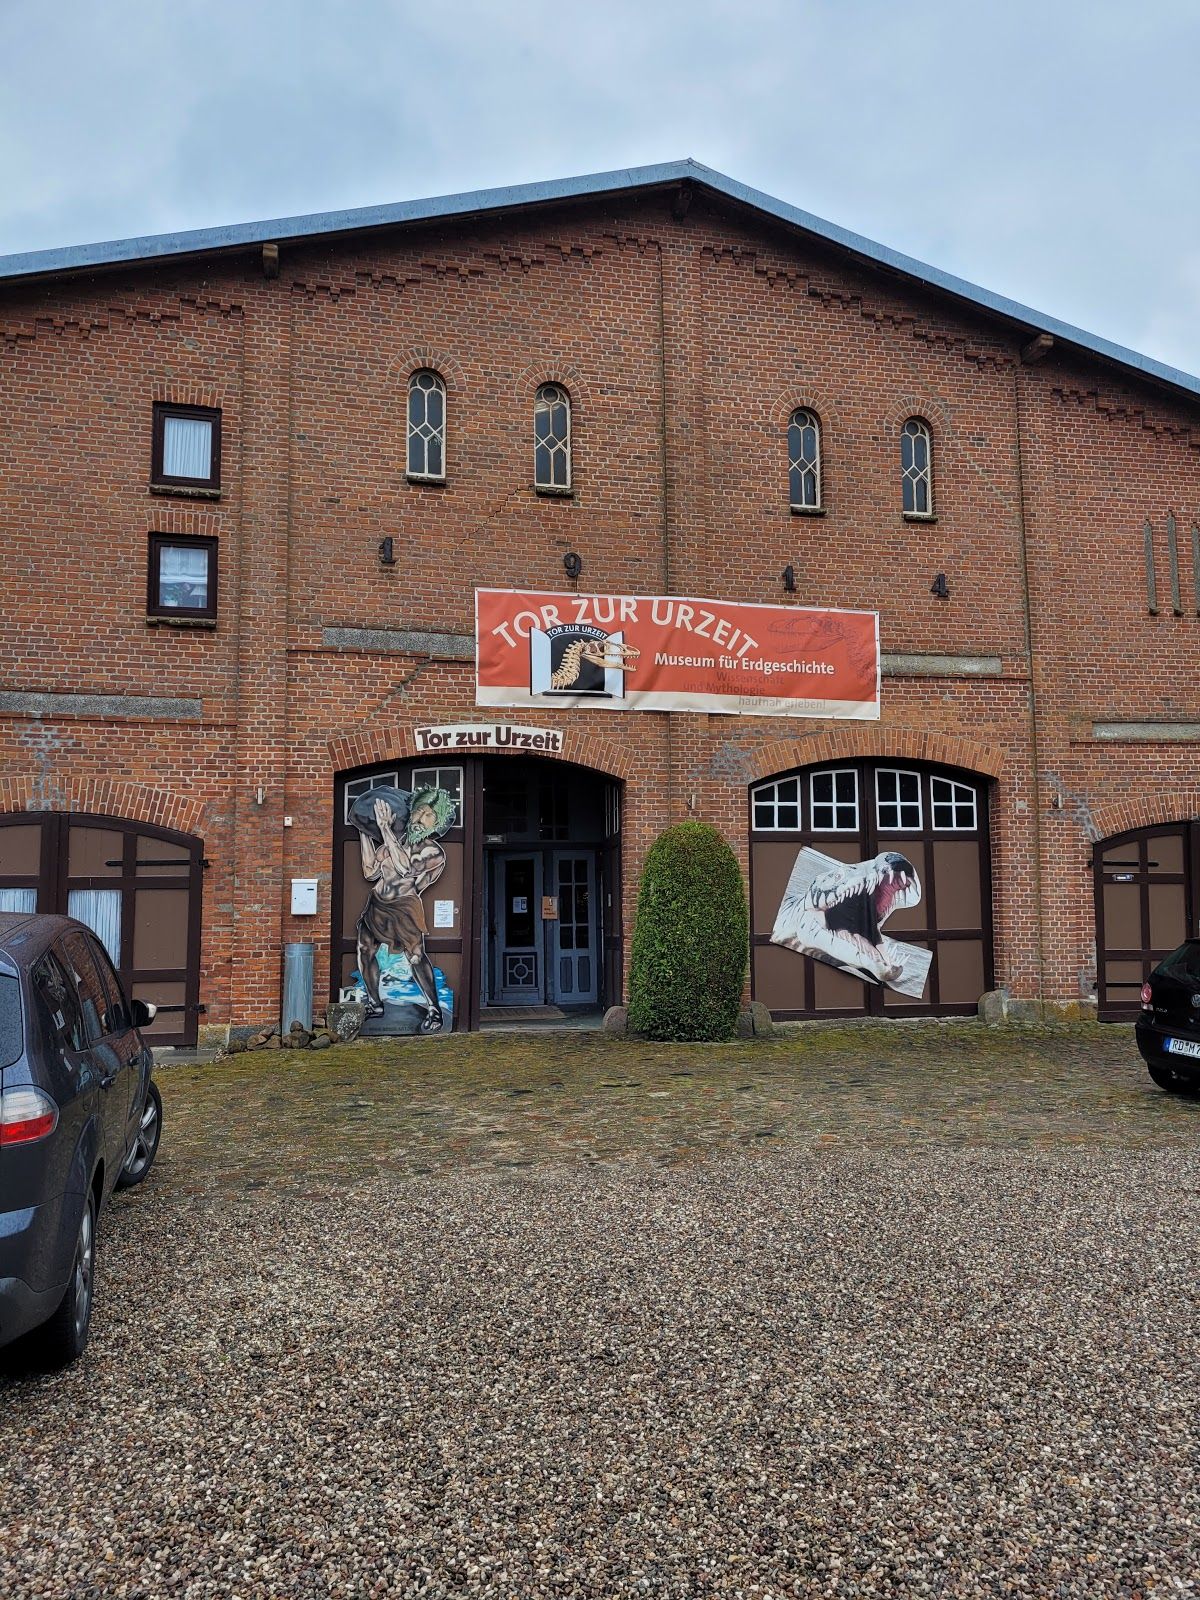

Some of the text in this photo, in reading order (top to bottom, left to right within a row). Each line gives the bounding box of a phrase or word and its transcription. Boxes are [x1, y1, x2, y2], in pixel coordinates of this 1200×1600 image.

[379, 537, 949, 597] 1 9 1 4
[492, 598, 759, 658] TOR ZUR URZEIT
[547, 626, 563, 637] TOR
[581, 625, 608, 639] URZEIT
[655, 652, 835, 675] Museum für Erdgeschichte
[706, 682, 765, 697] Mythologie
[716, 671, 785, 685] Wissenschaft
[417, 726, 560, 750] Tor zur Urzeit
